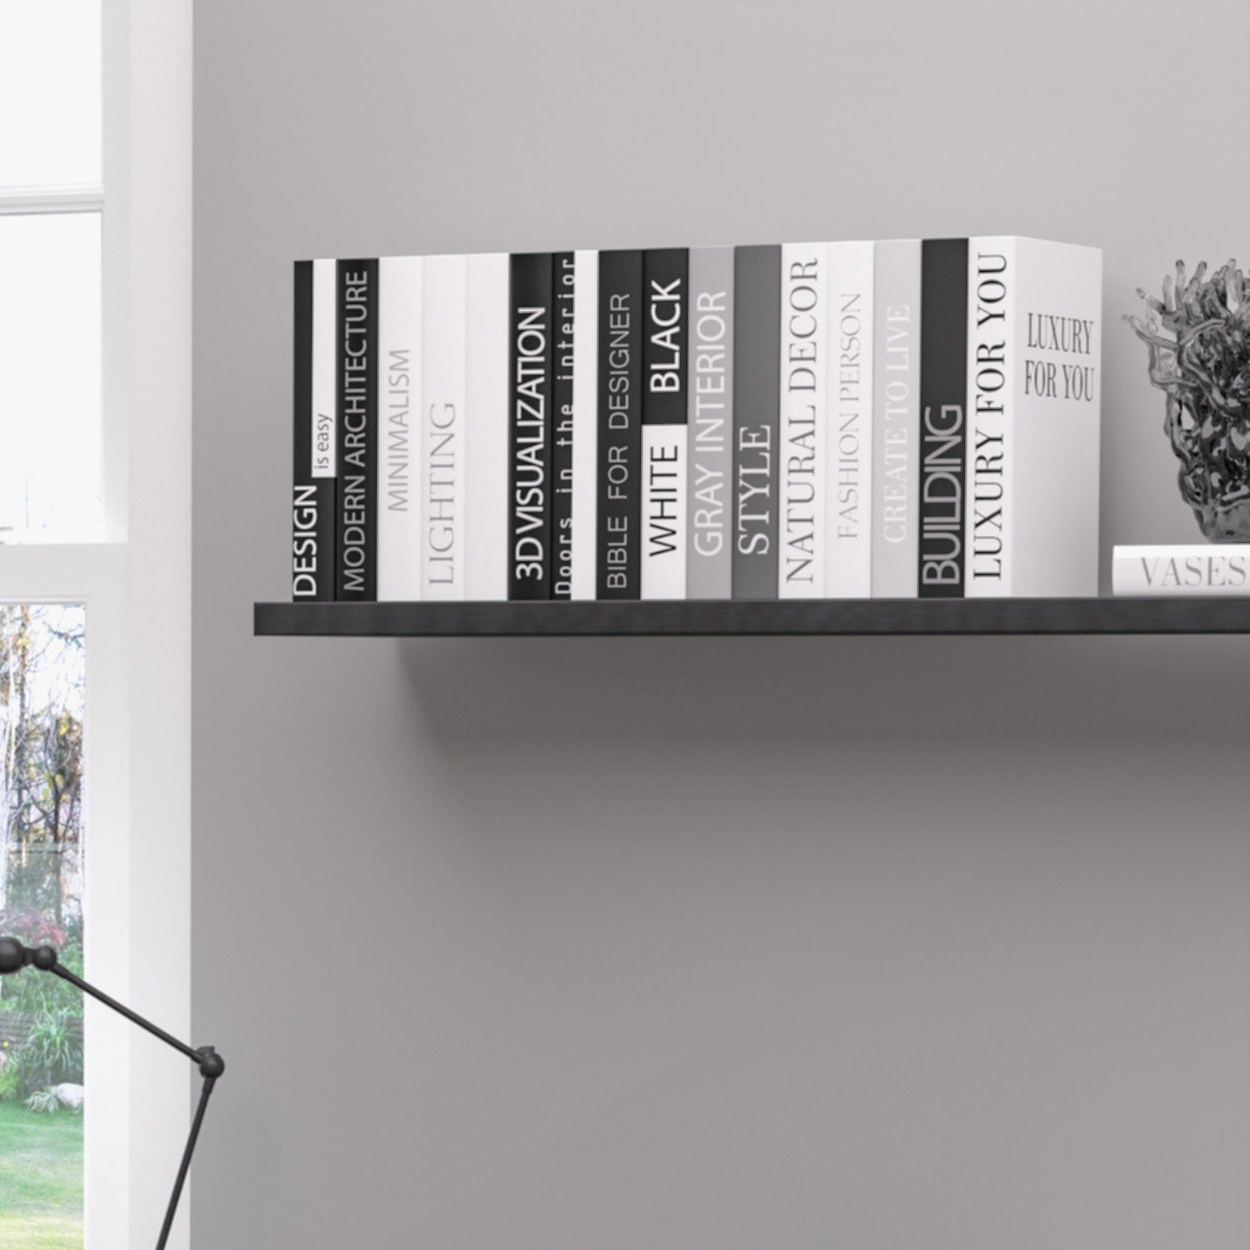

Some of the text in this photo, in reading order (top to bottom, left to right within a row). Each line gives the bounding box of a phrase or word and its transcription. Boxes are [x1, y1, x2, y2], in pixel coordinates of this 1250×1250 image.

[651, 278, 681, 393] BLACK
[694, 291, 726, 557] GRAY INTERIOR
[786, 257, 818, 584] NATURAL DECOR
[838, 292, 861, 539] FASHION PERSON
[883, 304, 910, 544] CREATE TO LIVE
[973, 252, 1007, 581] LUXURY FOR YOU
[1025, 362, 1094, 402] FOR YOU
[1028, 312, 1094, 355] LUXURY
[314, 413, 333, 470] is easy
[343, 270, 368, 592] MODERN ARCHITECTURE
[388, 348, 410, 512] MINIMALISM
[429, 403, 456, 586] LIGHTING
[516, 306, 546, 581] 3D VISUALIZATION
[555, 258, 576, 595] Doors in the interior
[607, 293, 630, 589] BIBLE FOR DESIGNER
[649, 444, 678, 557] WHITE
[738, 423, 771, 555] STYLE
[922, 404, 962, 584] BUILDING
[293, 484, 318, 597] DESIGN
[1141, 556, 1247, 587] VASES
